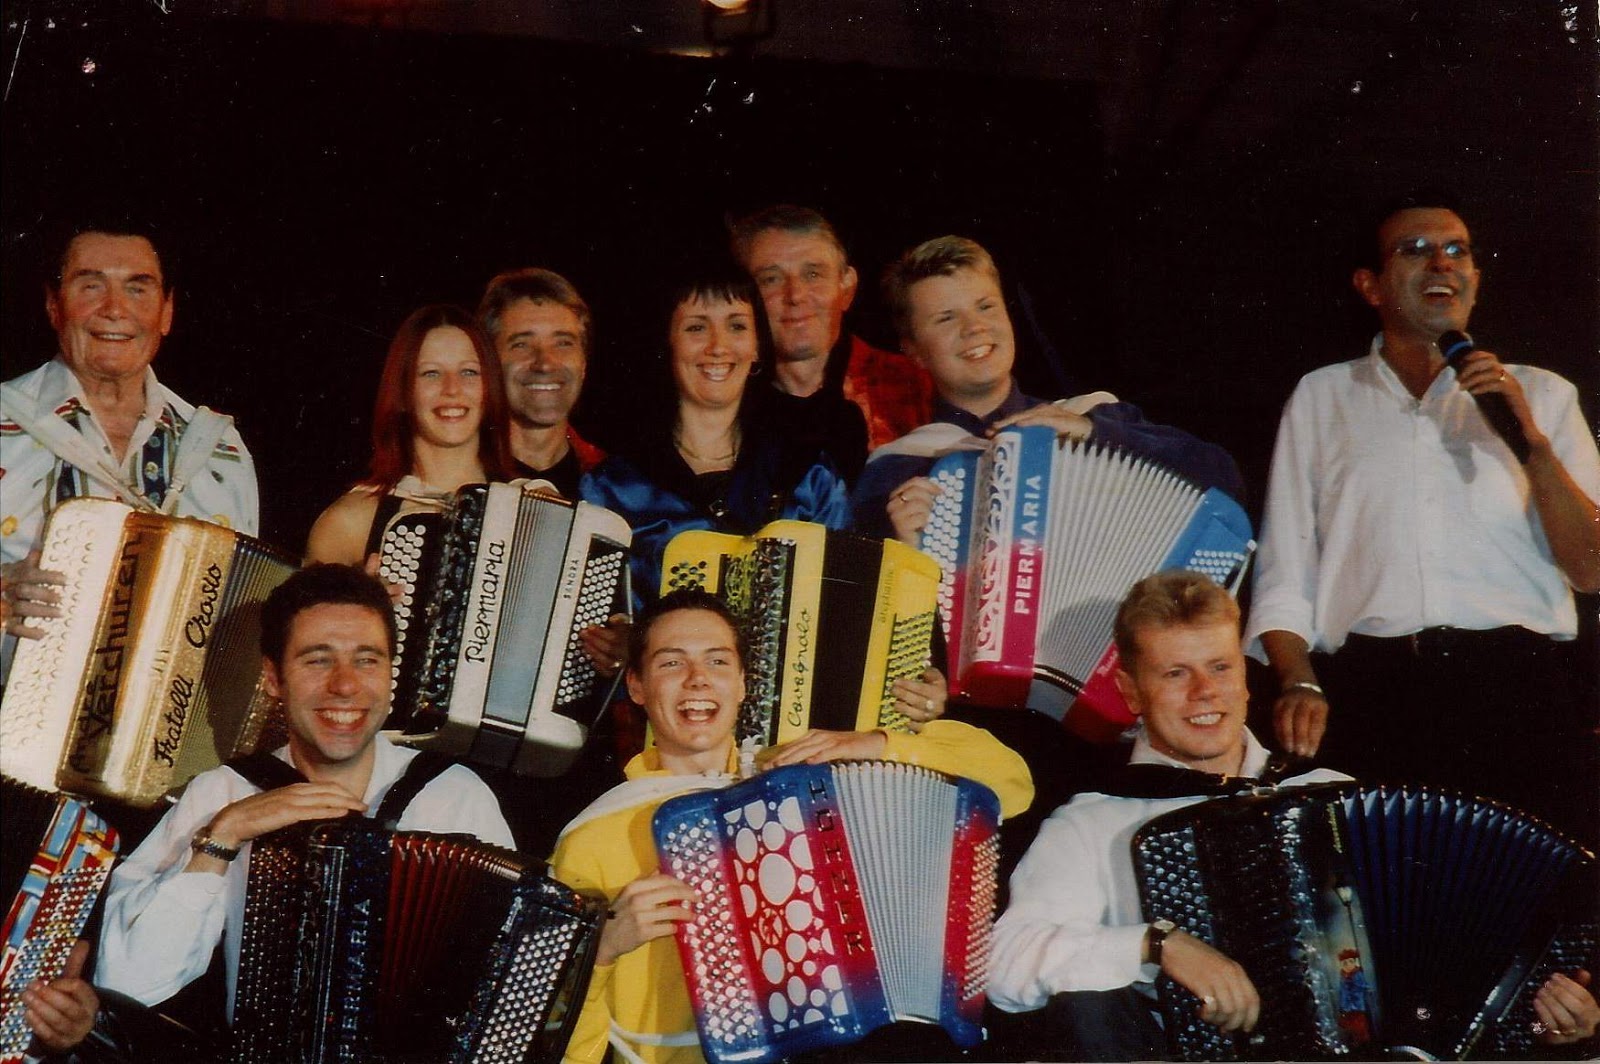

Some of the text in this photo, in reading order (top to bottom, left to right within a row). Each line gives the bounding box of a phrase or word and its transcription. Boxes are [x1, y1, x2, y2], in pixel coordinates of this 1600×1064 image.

[464, 540, 505, 663] Piermaria
[1014, 475, 1041, 614] PIERMARIA
[92, 533, 141, 736] Verchuren
[153, 563, 222, 768] Fratelli Crosio
[808, 778, 866, 955] HOHNER
